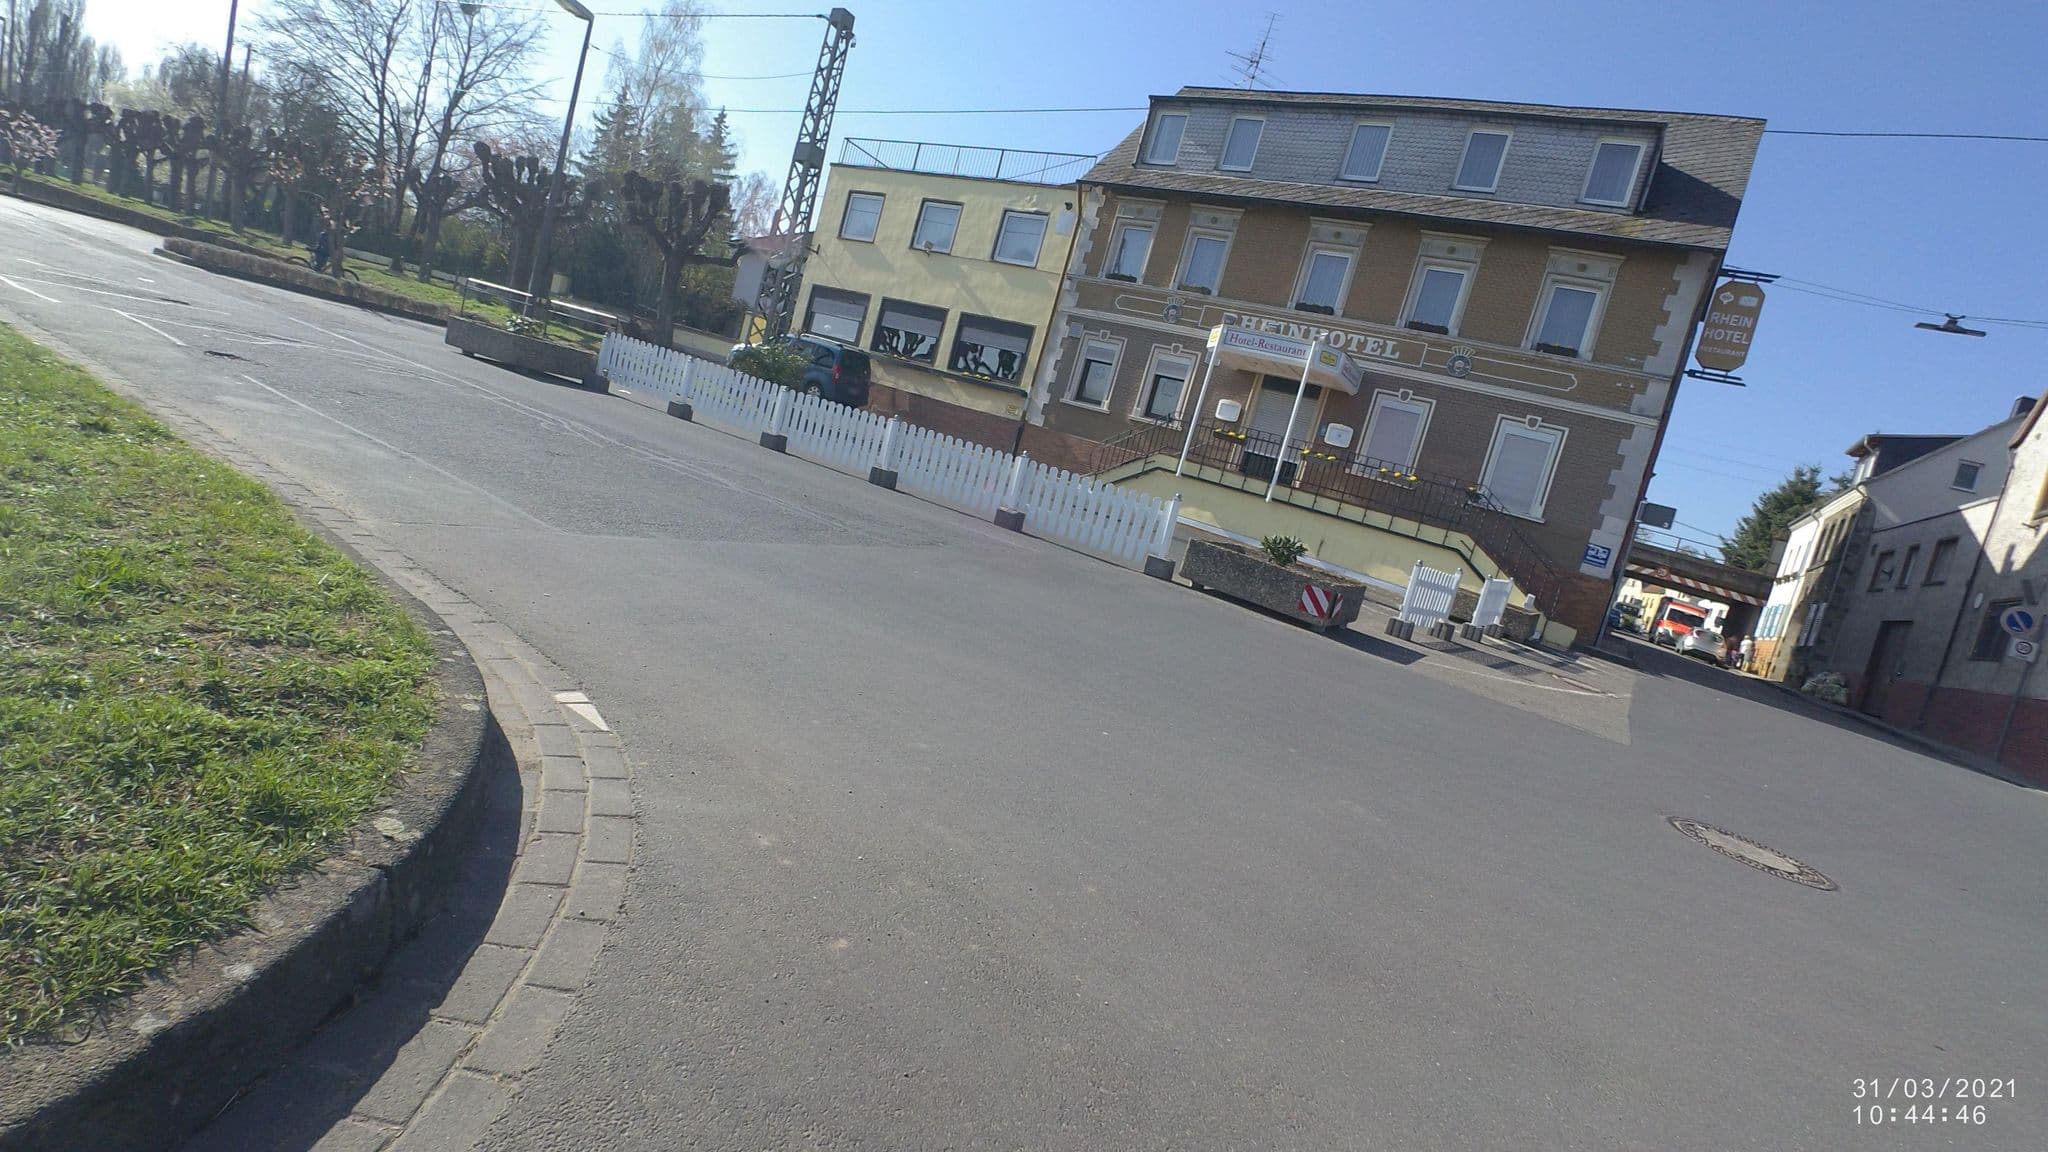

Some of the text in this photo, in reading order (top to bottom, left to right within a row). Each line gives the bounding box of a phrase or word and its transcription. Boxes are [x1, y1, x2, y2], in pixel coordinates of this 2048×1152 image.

[1709, 311, 1753, 328] RHEIN
[1223, 313, 1400, 359] HEINHOTEL
[1229, 333, 1307, 356] Hotel-Restaurant
[1704, 328, 1749, 345] HOTEL
